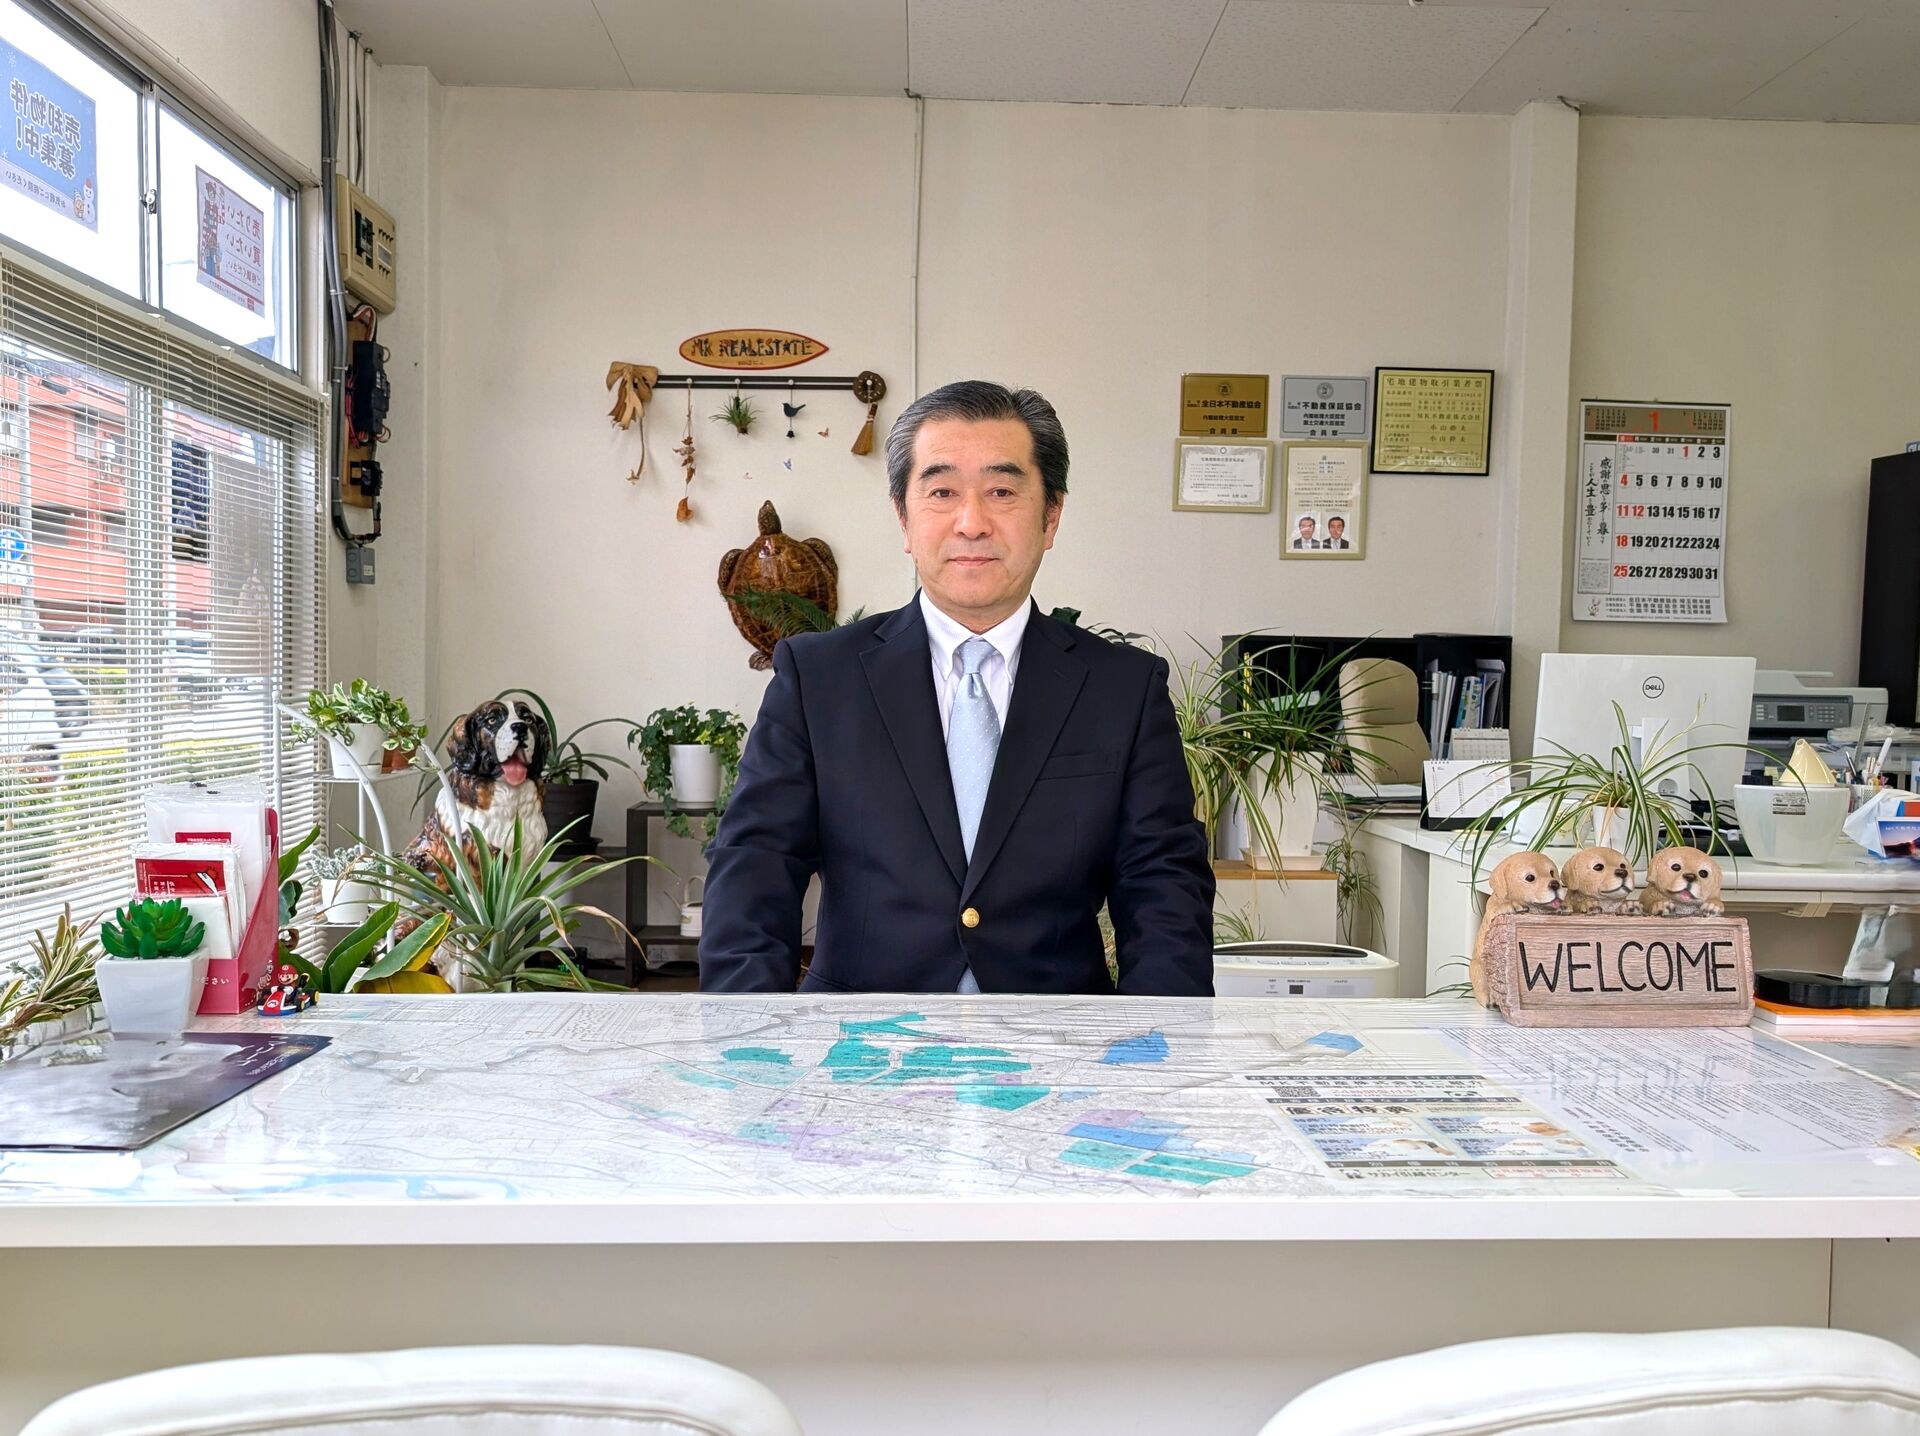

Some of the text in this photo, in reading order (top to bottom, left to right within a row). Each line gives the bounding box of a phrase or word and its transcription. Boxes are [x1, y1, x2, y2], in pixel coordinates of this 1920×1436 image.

[1386, 378, 1483, 388] 宅地建物取引業者票
[1201, 400, 1262, 409] 全日本不動産協会
[1302, 401, 1362, 411] 不動産保証協会
[1649, 410, 1660, 432] 1
[1209, 427, 1238, 435] 会員章
[1309, 429, 1339, 437] 会員章
[1683, 446, 1690, 457] 1
[1697, 446, 1705, 458] 2
[1713, 446, 1720, 458] 3
[1620, 474, 1722, 489] 4 5 6 7 8 9 10
[1617, 505, 1720, 519] 11 12 13 14 15 16 17
[1616, 535, 1720, 549] 18 19 20 21 22 23 24
[1614, 566, 1718, 580] 25 26 27 28 29 30 31
[1518, 941, 1737, 993] WELCOME
